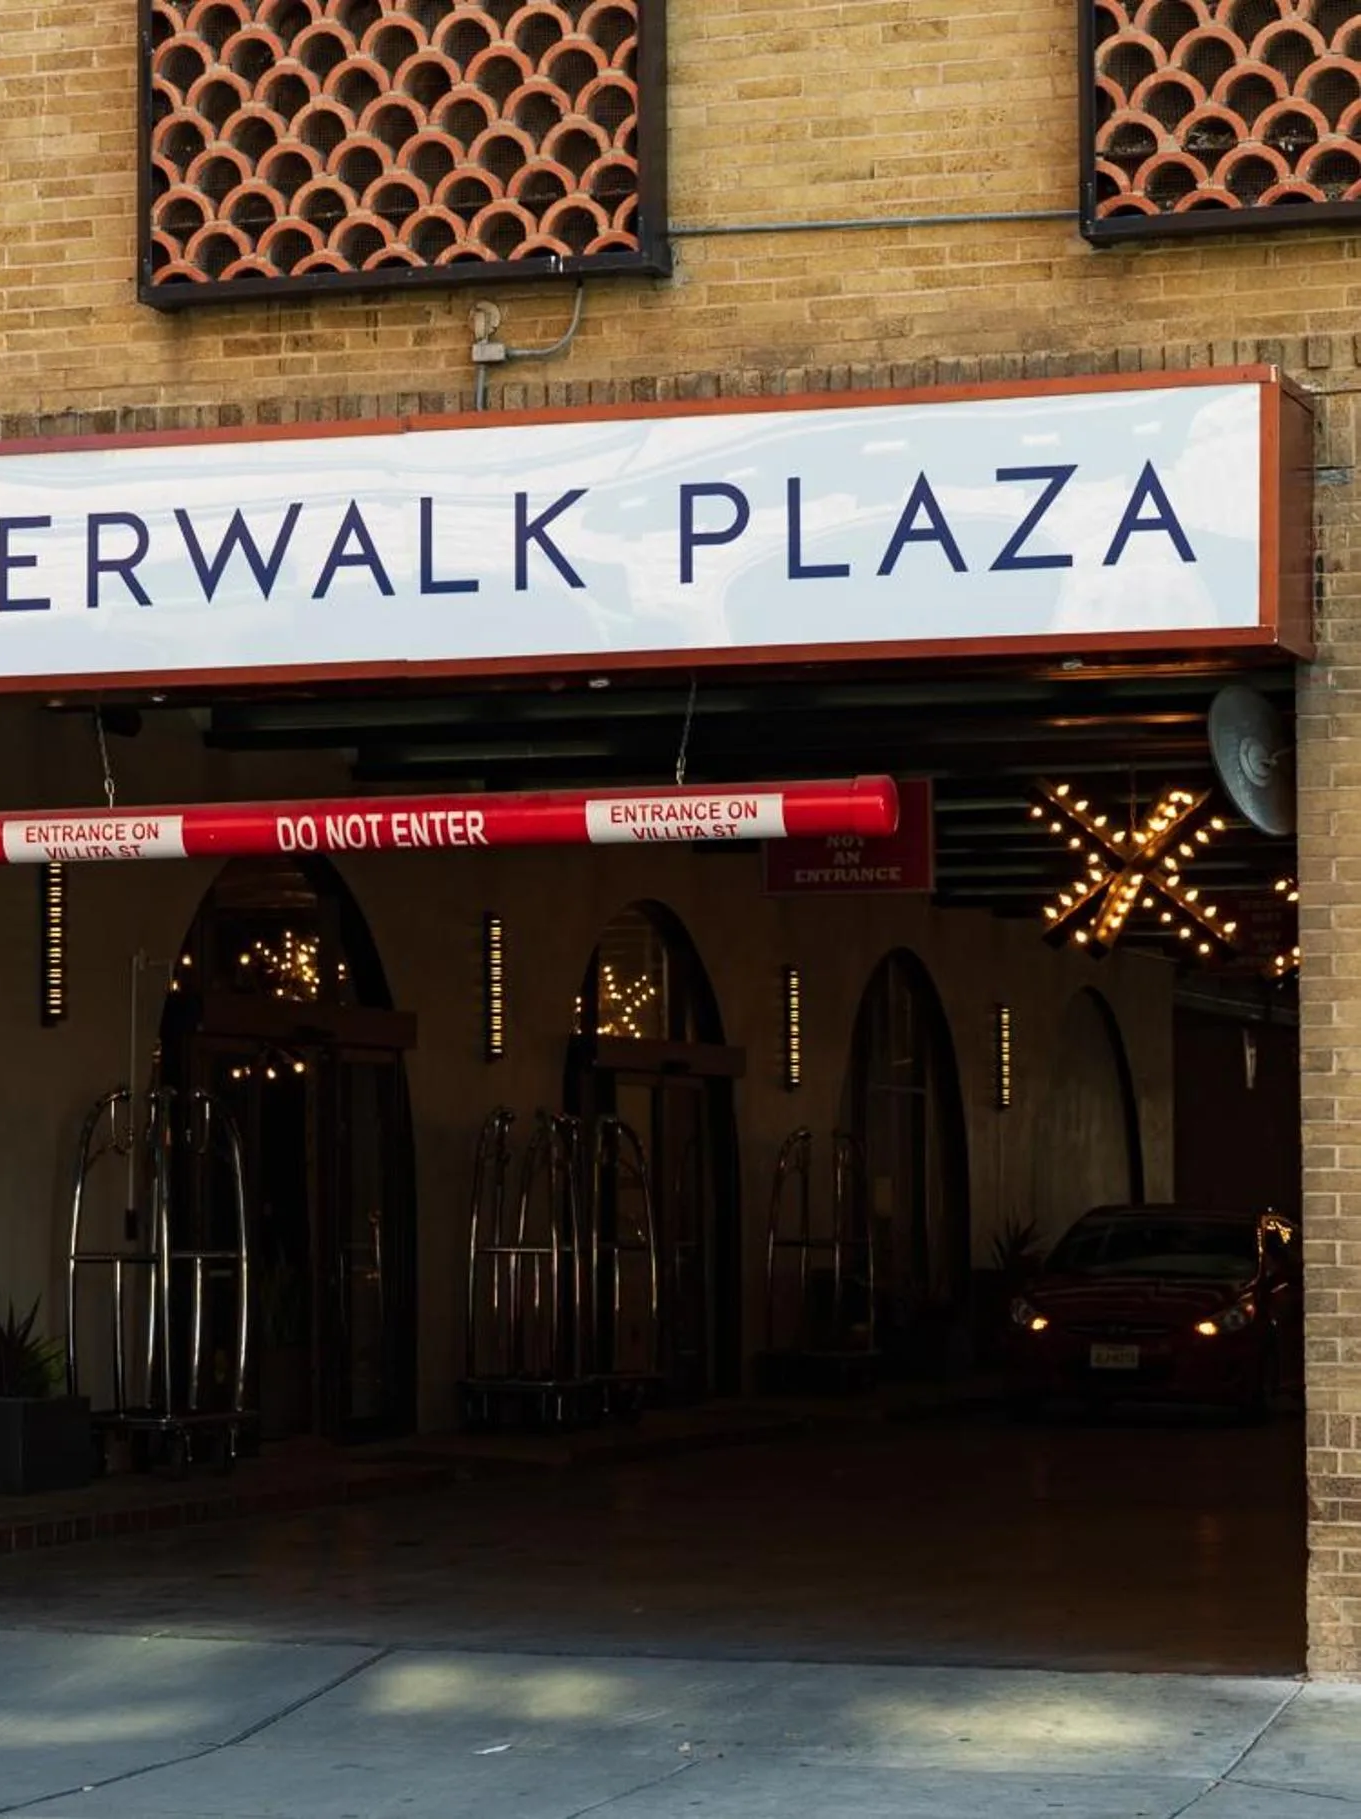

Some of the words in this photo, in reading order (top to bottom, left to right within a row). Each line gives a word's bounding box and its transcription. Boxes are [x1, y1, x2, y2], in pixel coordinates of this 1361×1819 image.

[679, 458, 1198, 584] PLAZA
[610, 802, 722, 824] ENTRANCE
[728, 800, 757, 819] ON
[25, 823, 126, 844] ENTRANCE
[132, 822, 159, 841] ON
[276, 815, 318, 852] DO
[325, 813, 383, 850] NOT
[391, 810, 489, 847] ENTER
[632, 825, 708, 841] VILLITA
[825, 833, 865, 848] NOT
[44, 844, 115, 861] VILLITA
[832, 850, 862, 866] AN
[794, 865, 902, 884] ENTRANCE
